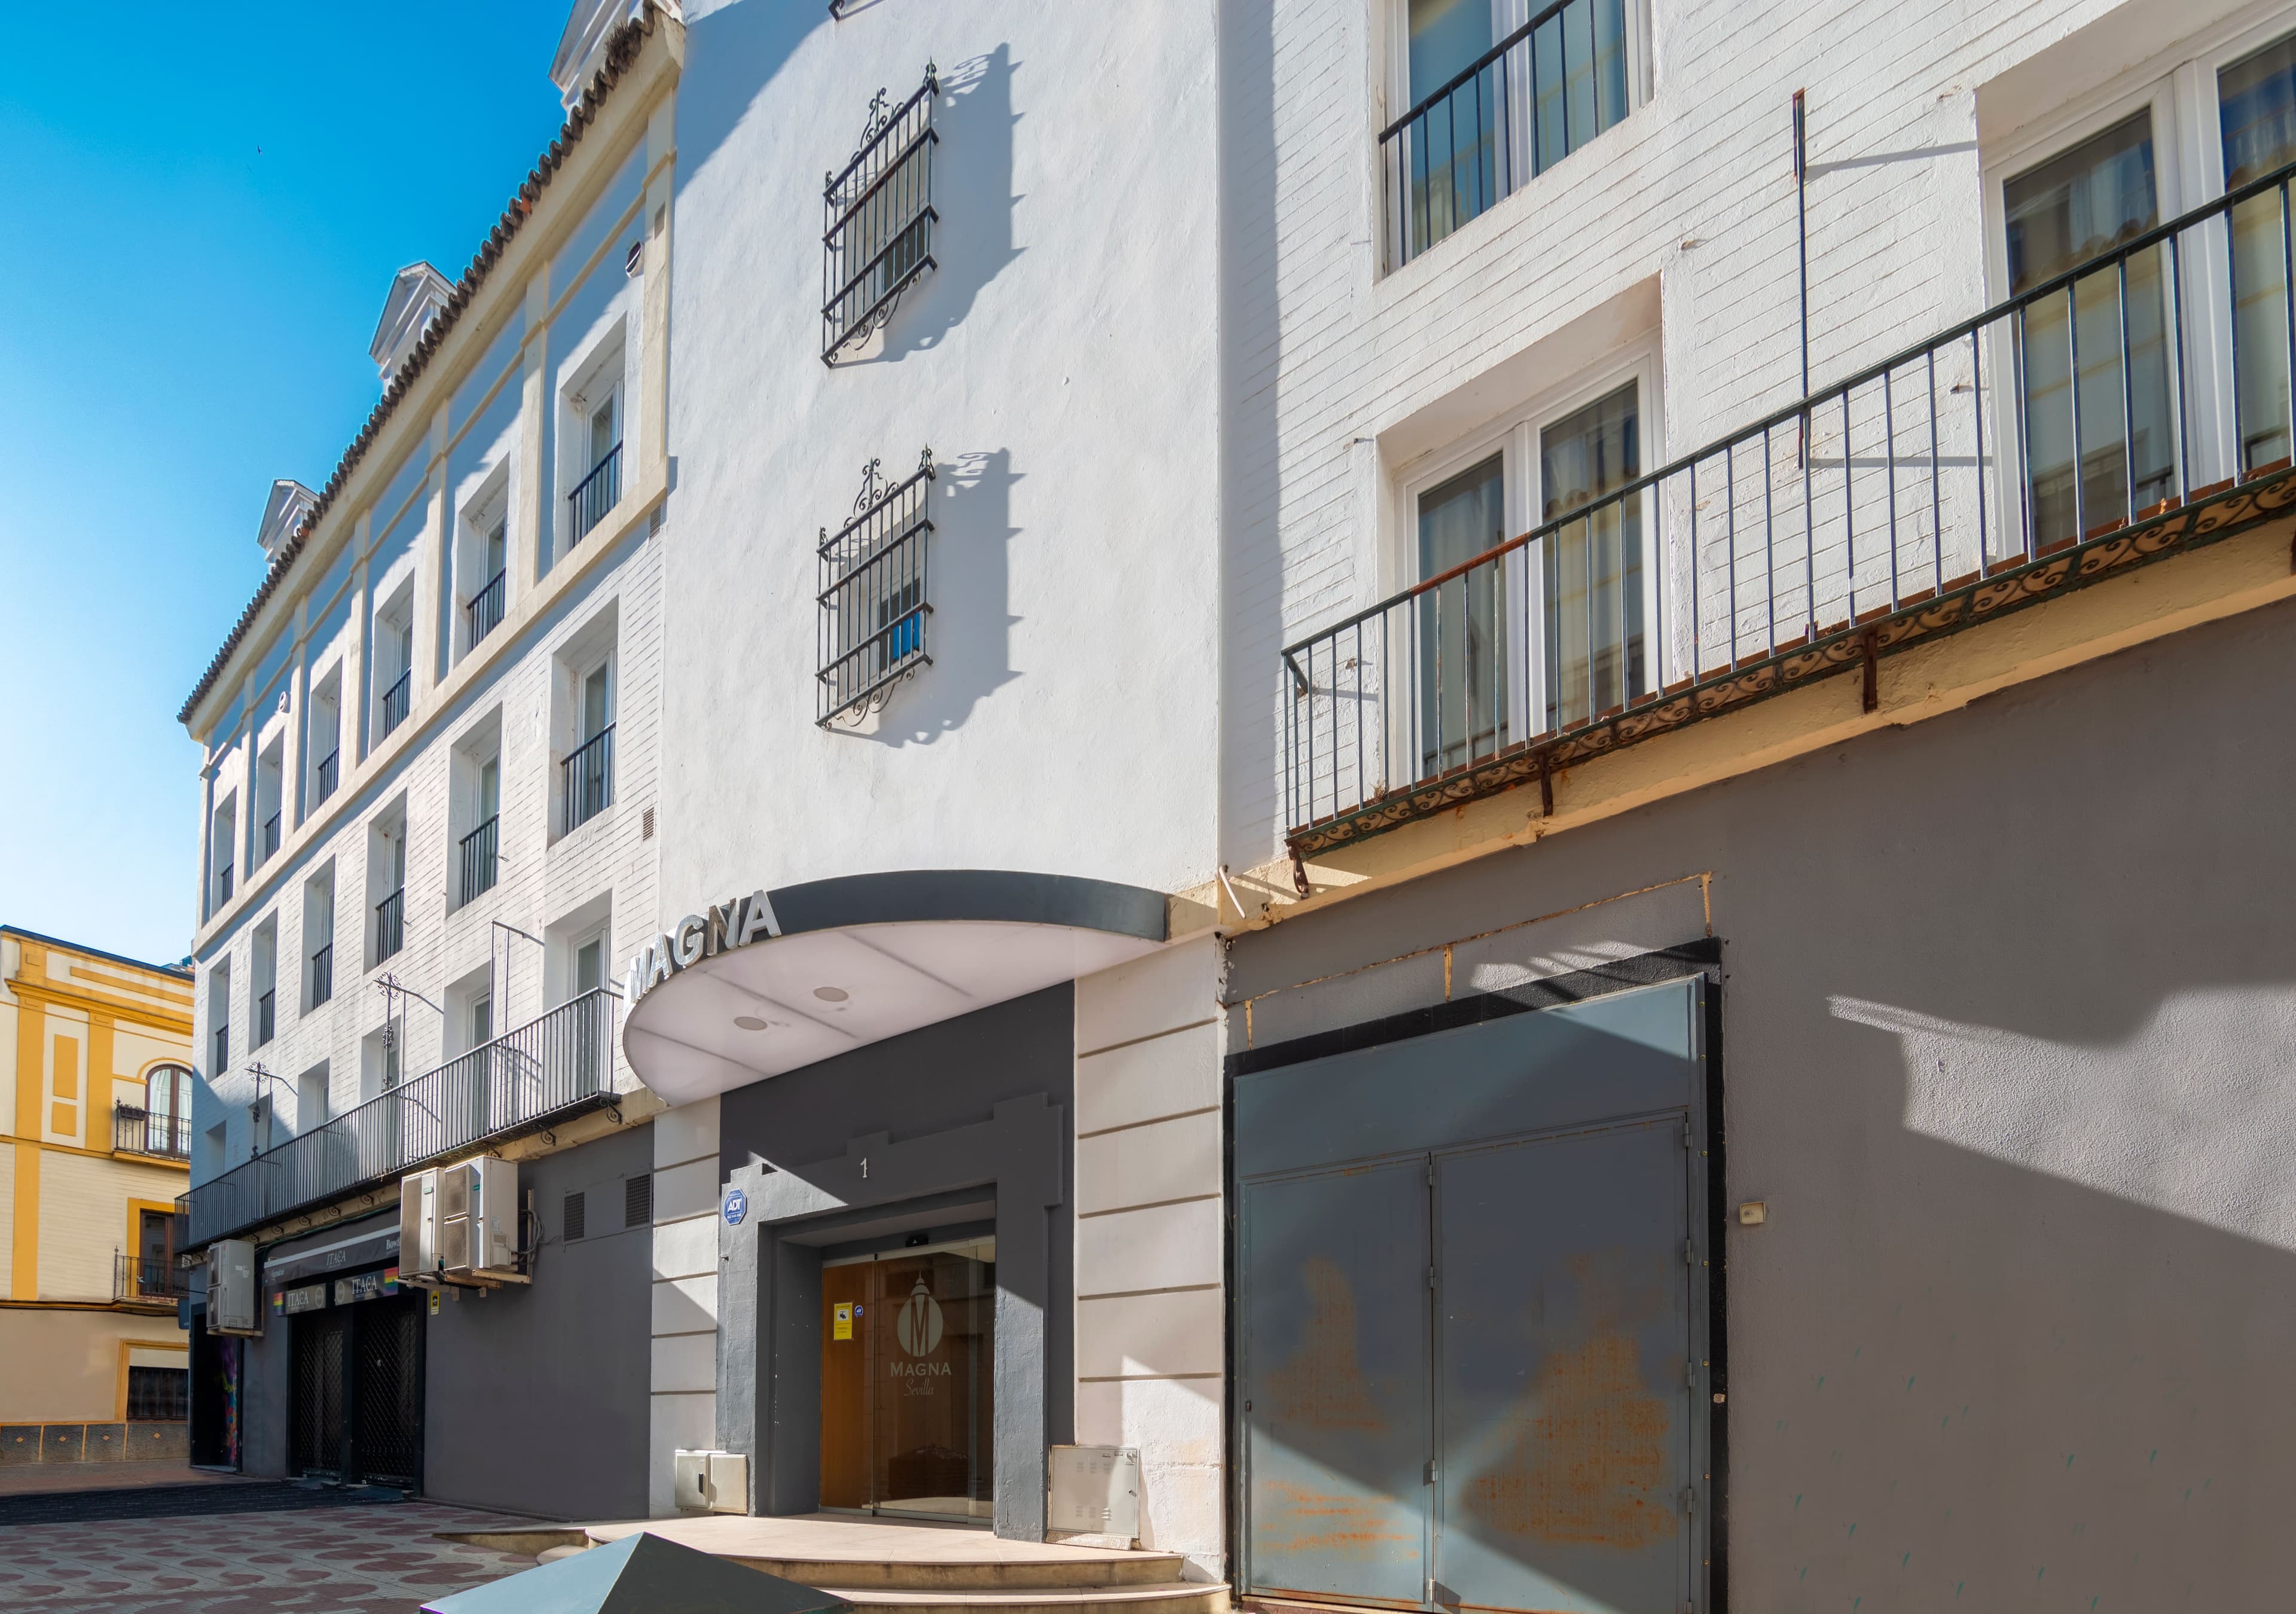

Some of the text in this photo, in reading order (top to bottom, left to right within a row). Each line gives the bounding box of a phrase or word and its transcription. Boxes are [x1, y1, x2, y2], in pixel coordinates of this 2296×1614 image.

[630, 889, 781, 1004] MAGNA
[860, 1158, 868, 1178] 1
[727, 1198, 741, 1212] ADT
[326, 1250, 346, 1266] ITACA
[352, 1275, 378, 1295] ITACA
[288, 1291, 309, 1307] ITACA
[890, 1361, 951, 1377] MAGNA
[904, 1377, 934, 1396] Sevilla
